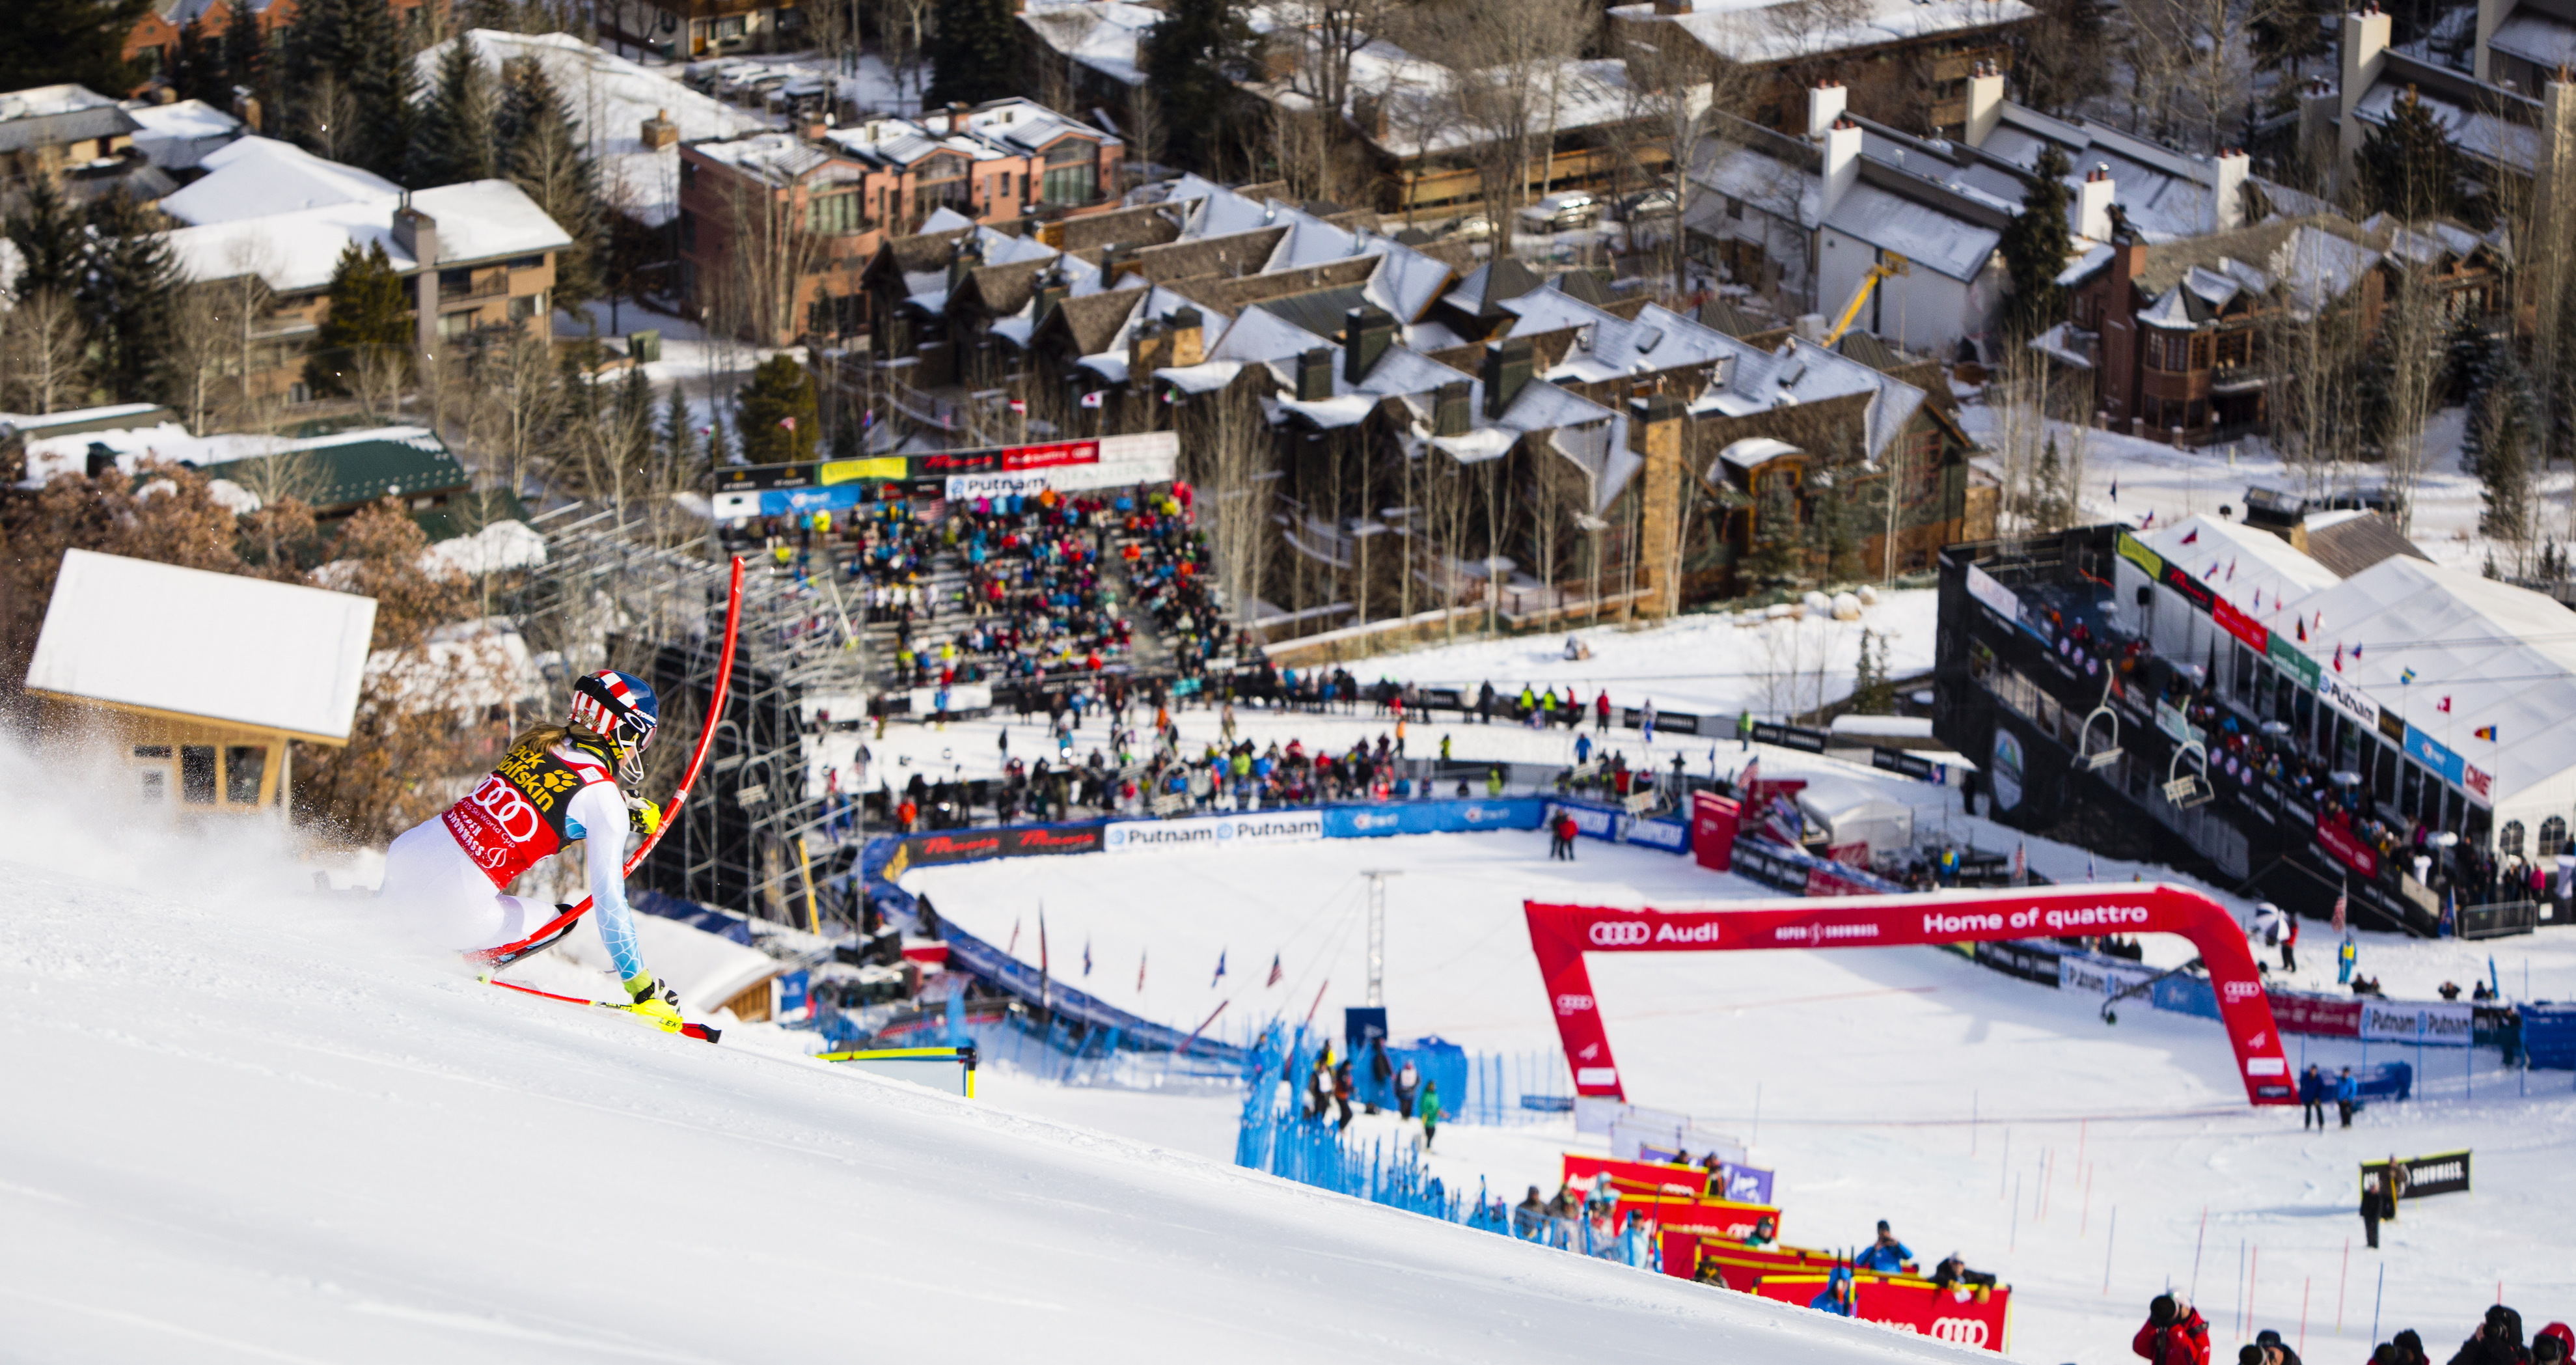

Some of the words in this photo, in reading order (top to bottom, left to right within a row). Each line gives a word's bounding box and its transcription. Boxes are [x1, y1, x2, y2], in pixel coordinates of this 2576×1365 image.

[2330, 683, 2375, 724] Putnam
[508, 745, 546, 769] ack
[459, 810, 483, 837] SPEN
[463, 800, 473, 811] FIS
[471, 807, 482, 816] Ski
[480, 812, 501, 834] World
[500, 833, 516, 848] Cup
[1238, 818, 1319, 839] Putnam
[1129, 825, 1213, 846] Putnam
[1924, 911, 2004, 933] Home
[2009, 907, 2040, 929] of
[2046, 905, 2148, 930] quattro
[1656, 922, 1719, 943] Audi
[1775, 926, 1807, 941] ASPEN
[1824, 923, 1879, 938] SNOWMASS
[658, 1017, 682, 1028] LEKI
[2371, 1009, 2416, 1030] Putnam
[1568, 1172, 1597, 1191] Aud
[2412, 1161, 2462, 1187] SNOWMASS
